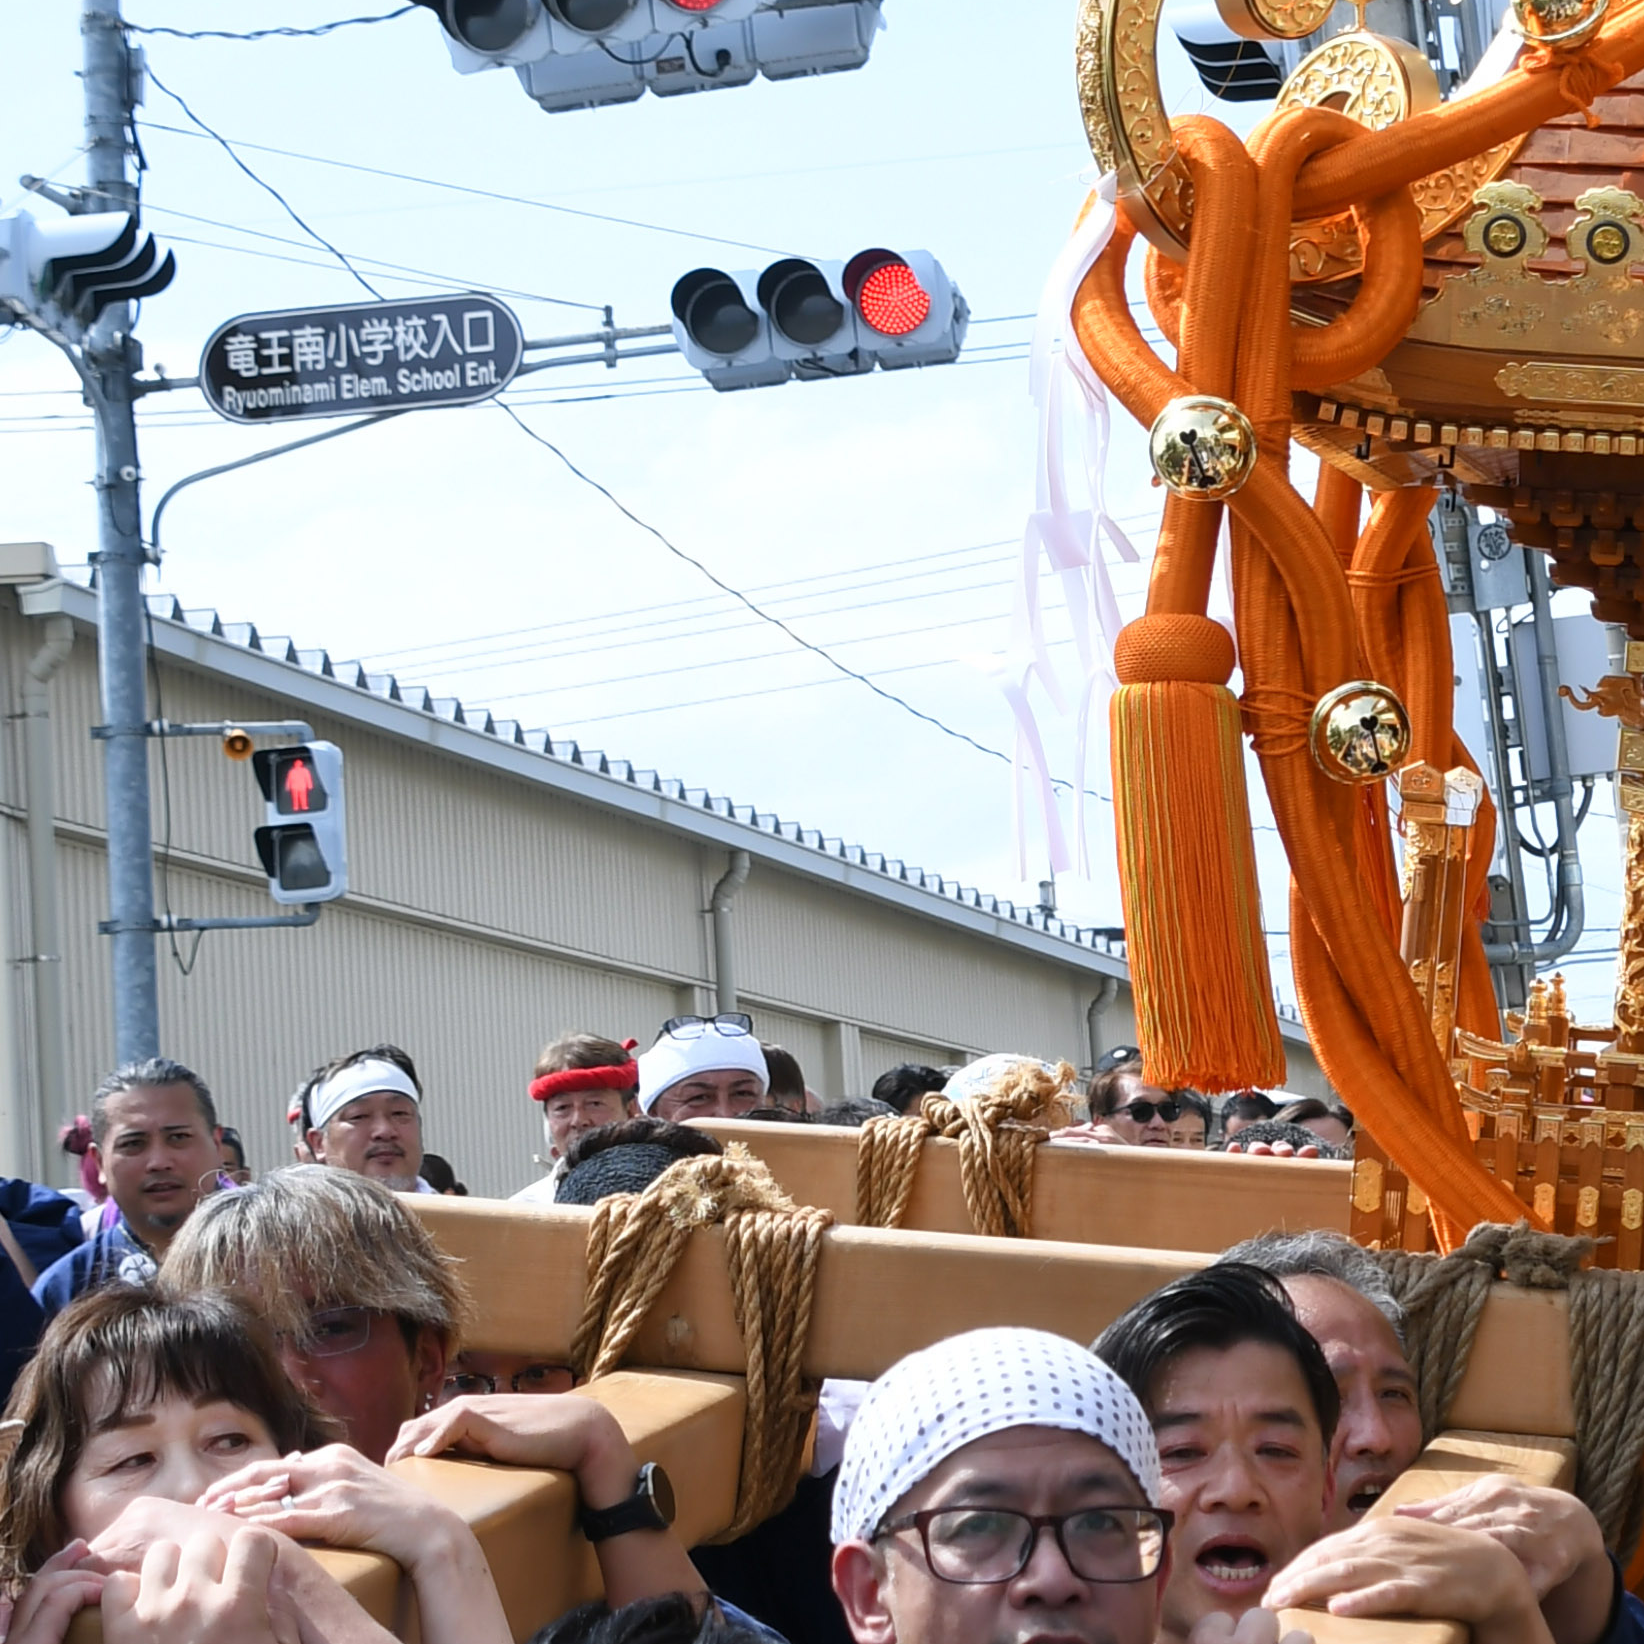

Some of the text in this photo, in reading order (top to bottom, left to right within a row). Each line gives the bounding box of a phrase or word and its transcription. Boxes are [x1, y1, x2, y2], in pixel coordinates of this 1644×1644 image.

[223, 310, 496, 378] 竜王南小学校入口
[222, 360, 501, 414] Ryuominami Elem. School Ent.
